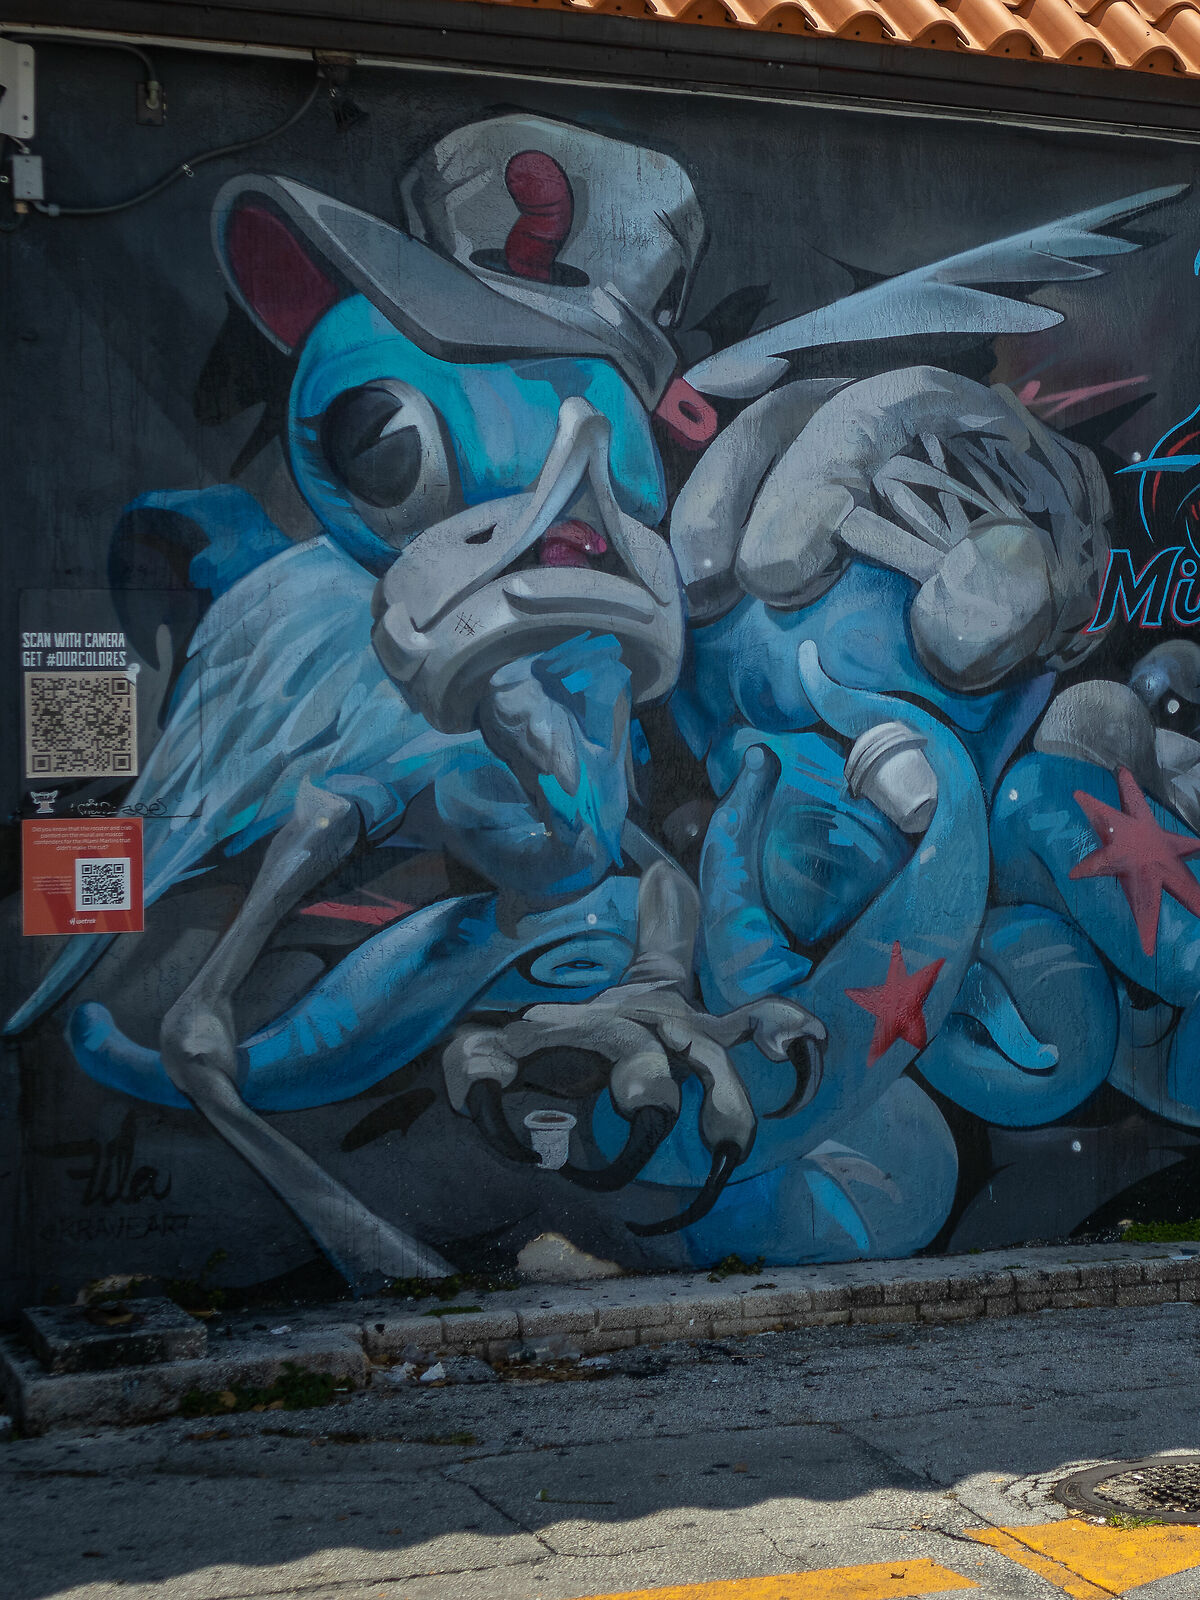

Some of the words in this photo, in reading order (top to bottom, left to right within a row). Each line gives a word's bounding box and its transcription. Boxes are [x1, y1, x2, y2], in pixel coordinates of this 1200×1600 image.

[22, 632, 51, 648] SCAN
[54, 632, 81, 648] WITH
[85, 632, 125, 648] CAMERA
[23, 651, 43, 667] GET
[46, 651, 127, 667] #OURCOLORES
